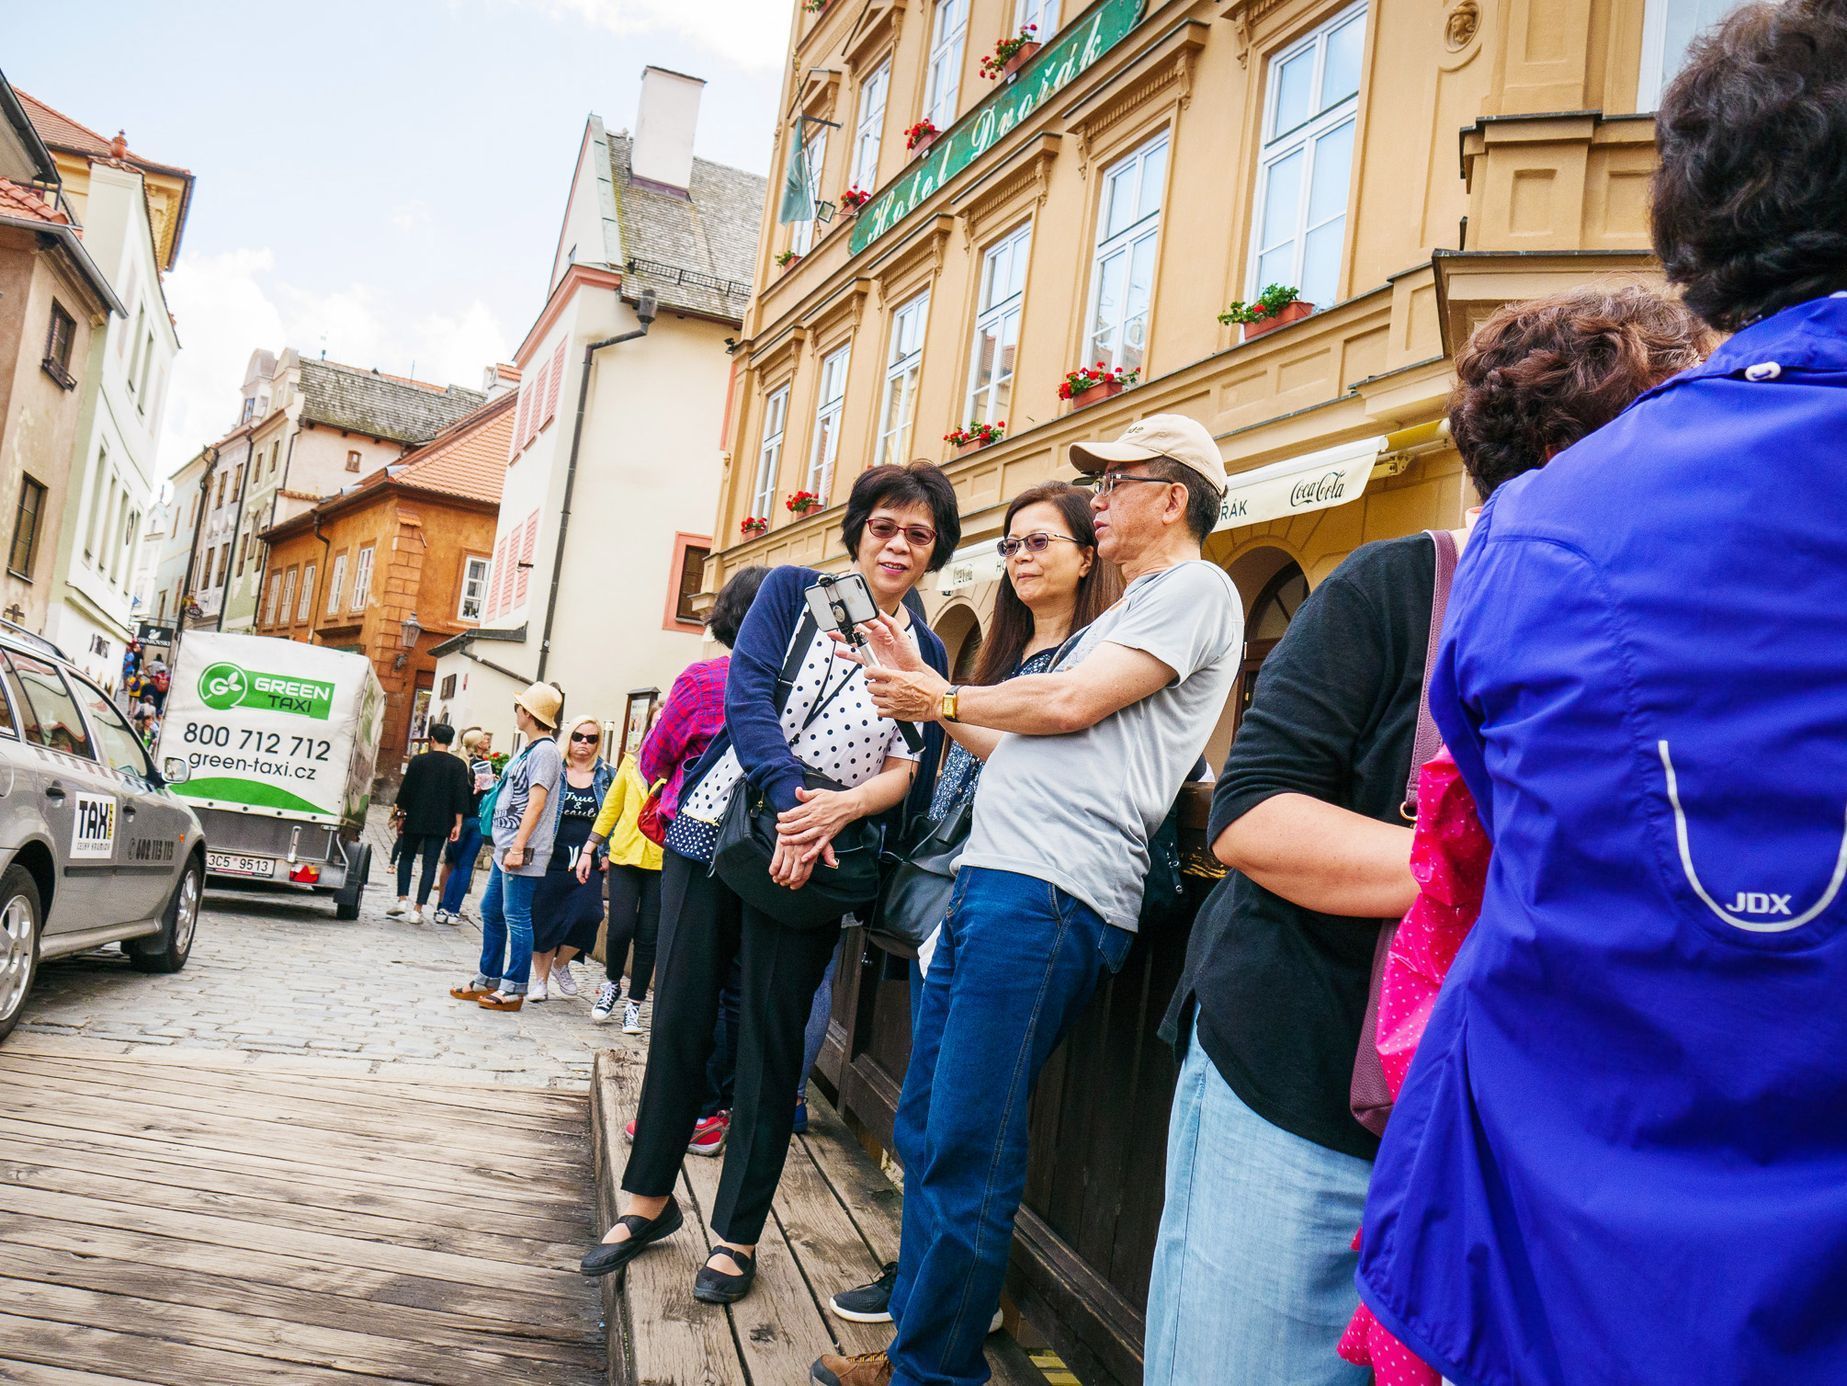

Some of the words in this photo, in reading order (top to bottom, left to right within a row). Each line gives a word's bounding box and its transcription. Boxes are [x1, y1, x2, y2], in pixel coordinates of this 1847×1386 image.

[867, 140, 953, 244] Hotel
[971, 12, 1103, 161] Dvořák
[1220, 498, 1248, 521] ŘÁK
[254, 677, 331, 701] GREEN
[267, 694, 312, 713] TAXI
[183, 722, 230, 748] 800
[238, 729, 281, 755] 712
[289, 735, 332, 762] 712
[188, 752, 317, 781] green-taxi.cz
[565, 791, 595, 803] True
[208, 855, 231, 868] 3C5
[239, 858, 269, 872] 9513
[1725, 891, 1793, 915] JDX
